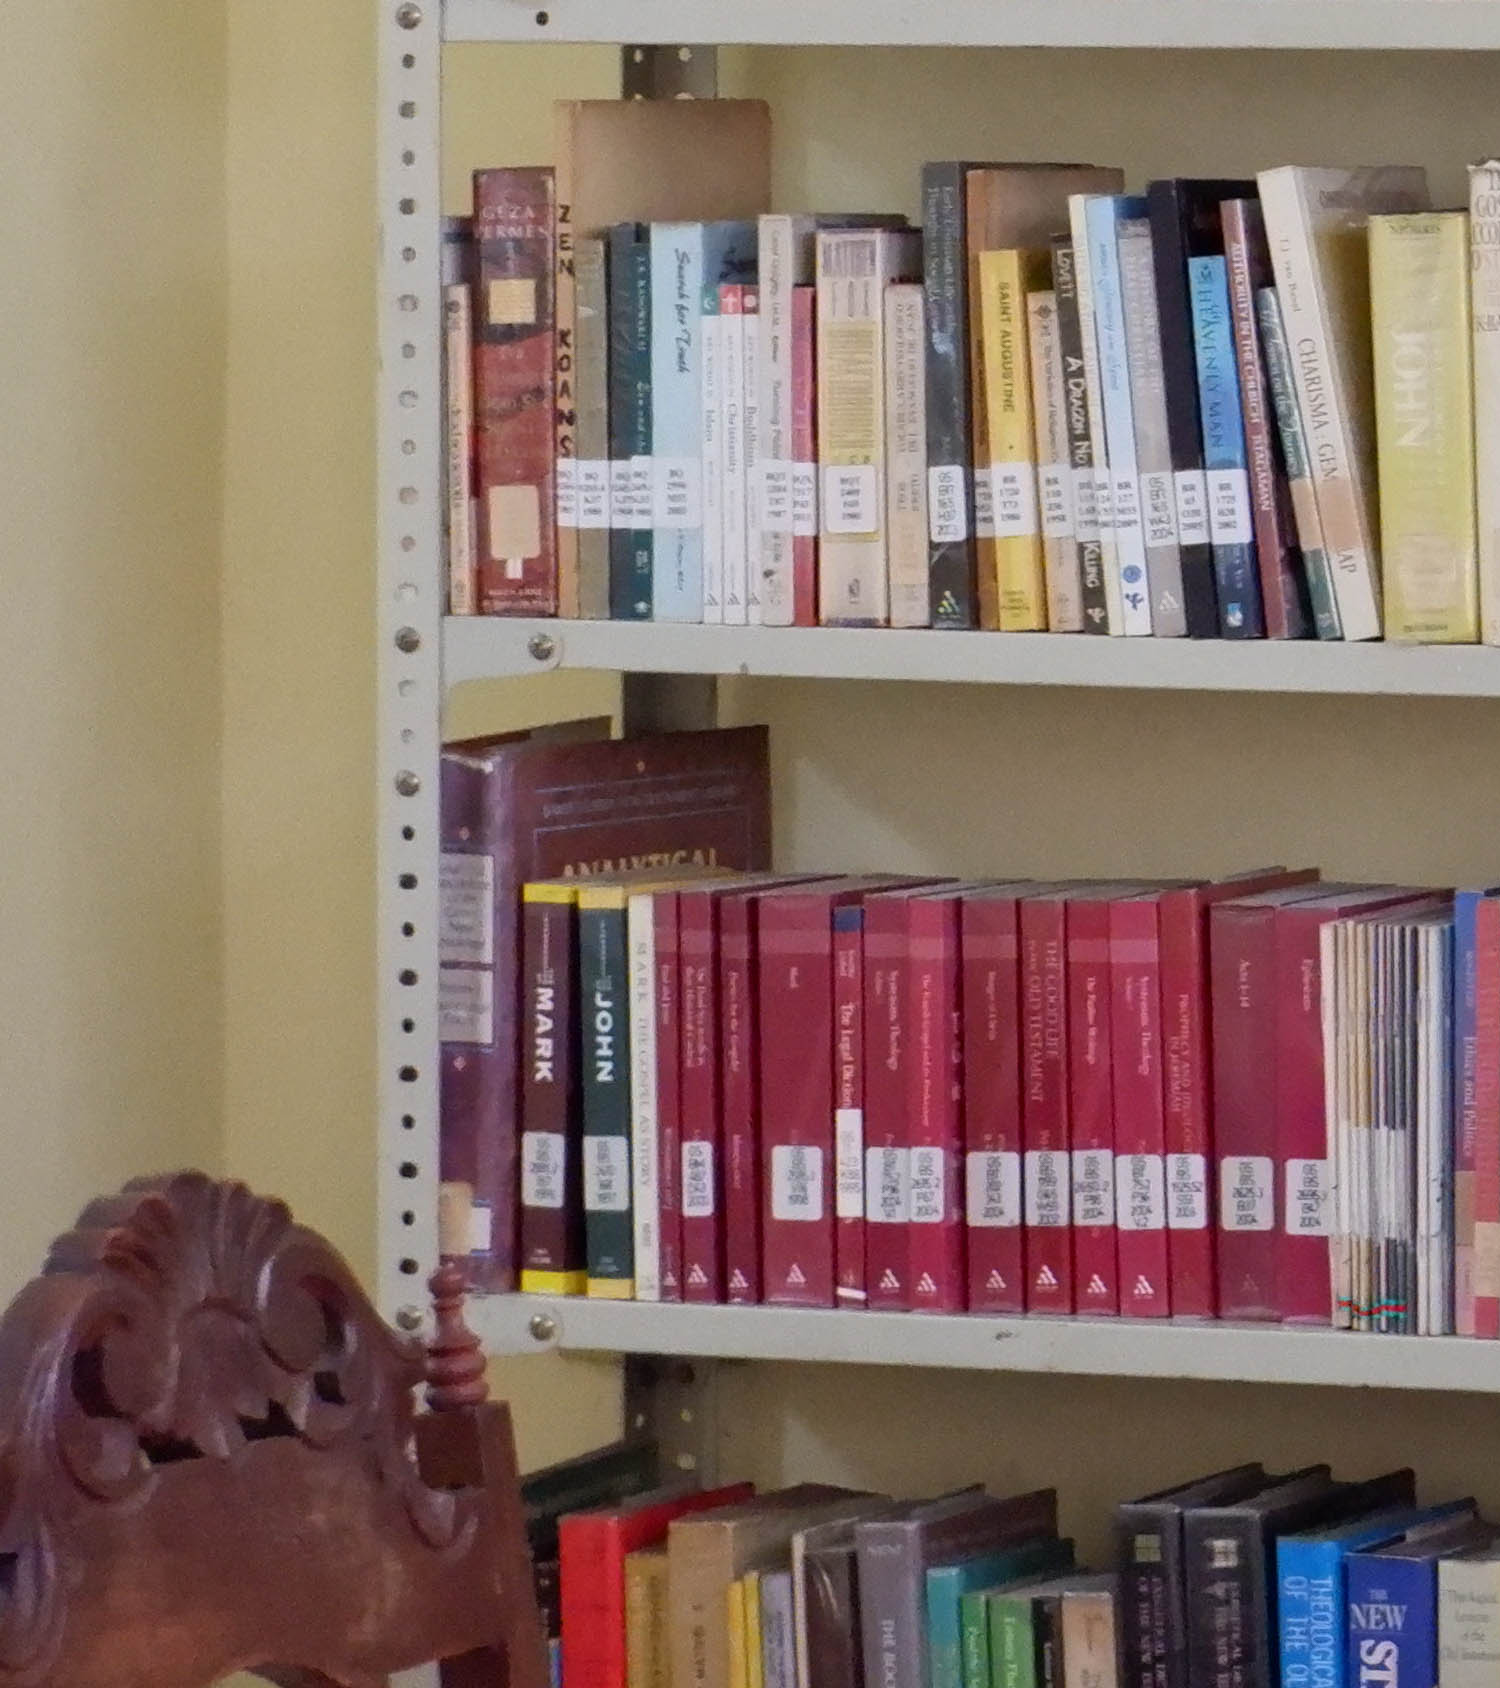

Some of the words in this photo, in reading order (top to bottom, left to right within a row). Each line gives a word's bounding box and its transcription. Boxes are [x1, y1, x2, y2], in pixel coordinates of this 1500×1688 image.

[997, 280, 1013, 324] SAINT
[999, 328, 1017, 414] AUGUSTINE
[1067, 377, 1087, 436] DRAGON
[1296, 336, 1329, 432] CHARISMA
[1206, 400, 1227, 449] MAN
[533, 987, 553, 1082] MARK
[594, 991, 615, 1083] JOHN
[1349, 1602, 1409, 1633] NEW
